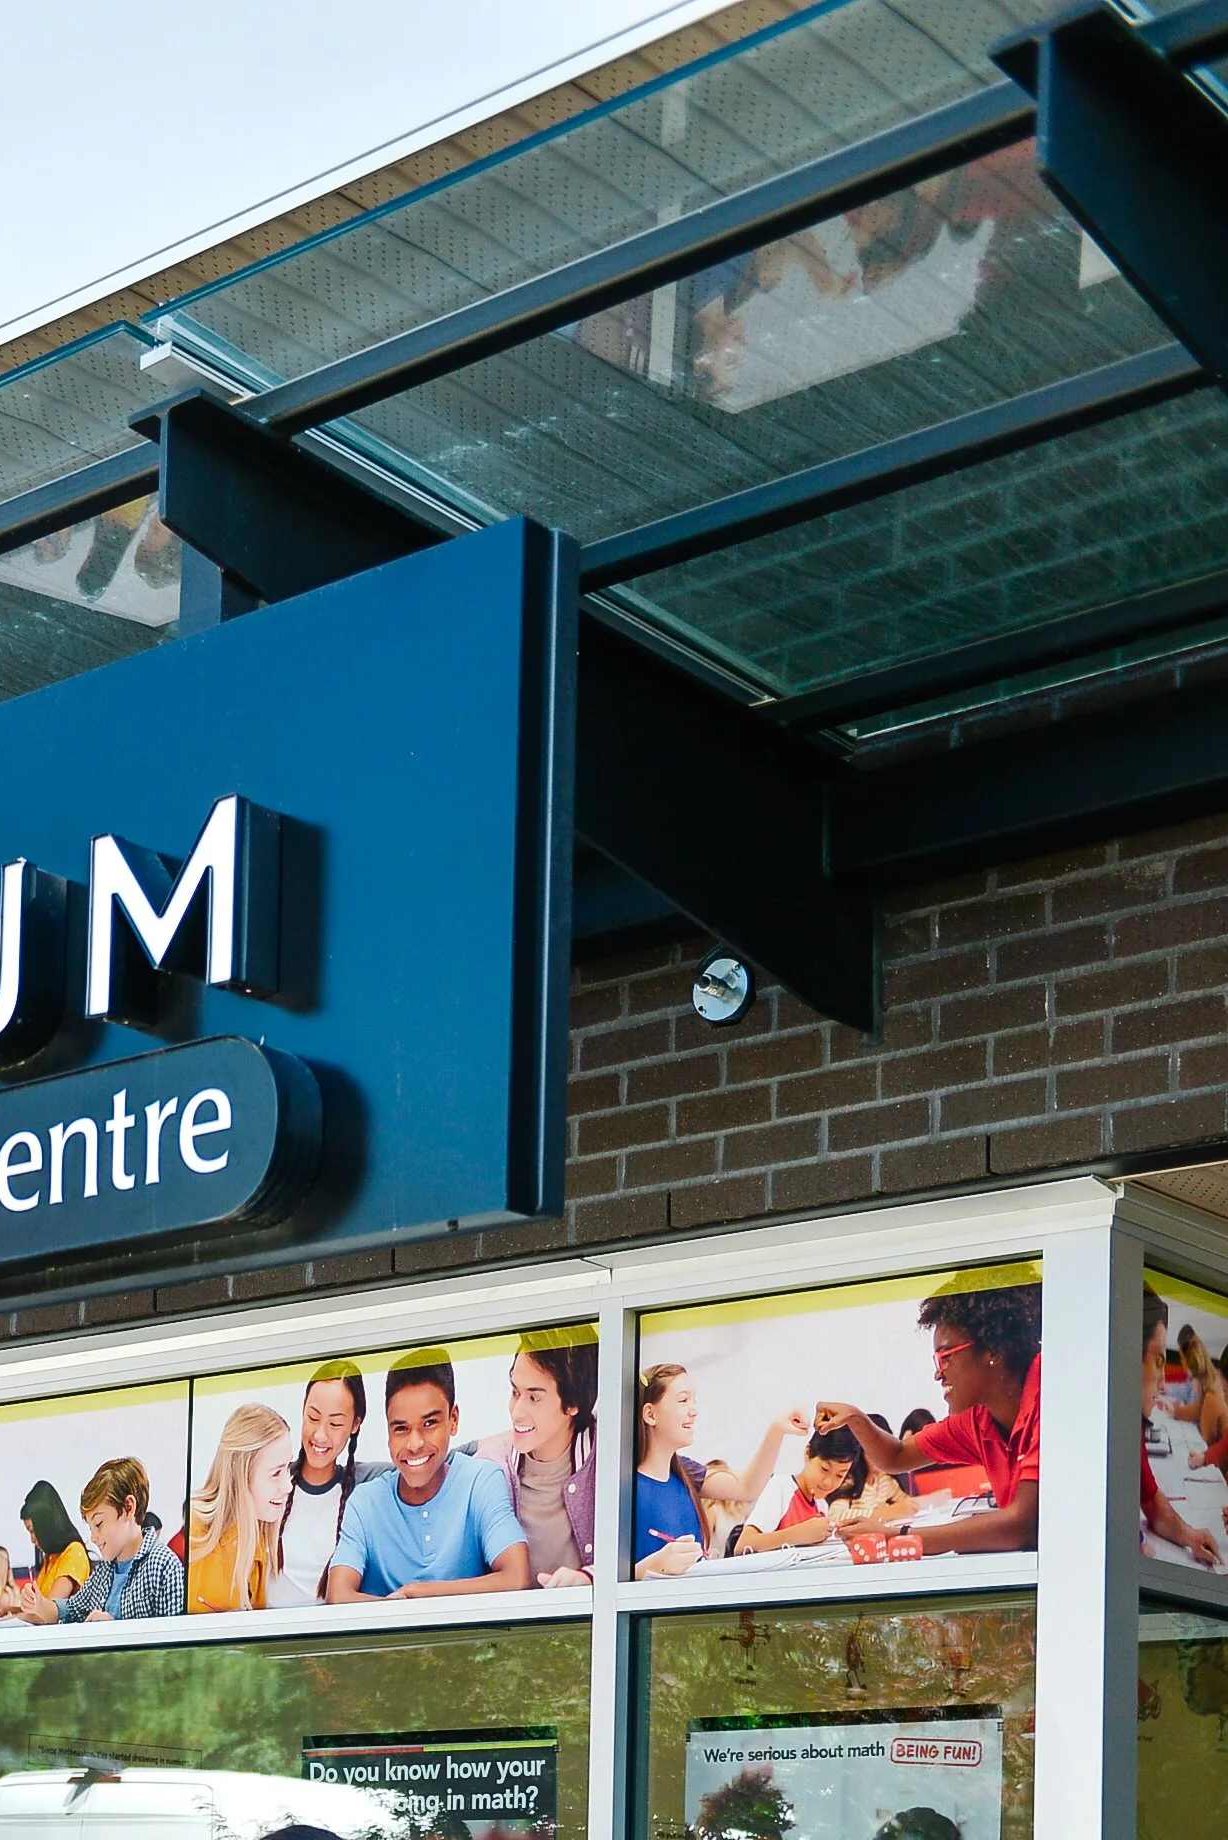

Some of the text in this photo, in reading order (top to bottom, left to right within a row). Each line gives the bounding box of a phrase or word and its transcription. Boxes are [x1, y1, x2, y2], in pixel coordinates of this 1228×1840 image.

[704, 1741, 885, 1763] We're serious about math
[896, 1744, 977, 1760] BEING FUN!
[310, 1756, 545, 1784] Do you know how your
[394, 1785, 539, 1817] oing in math?
